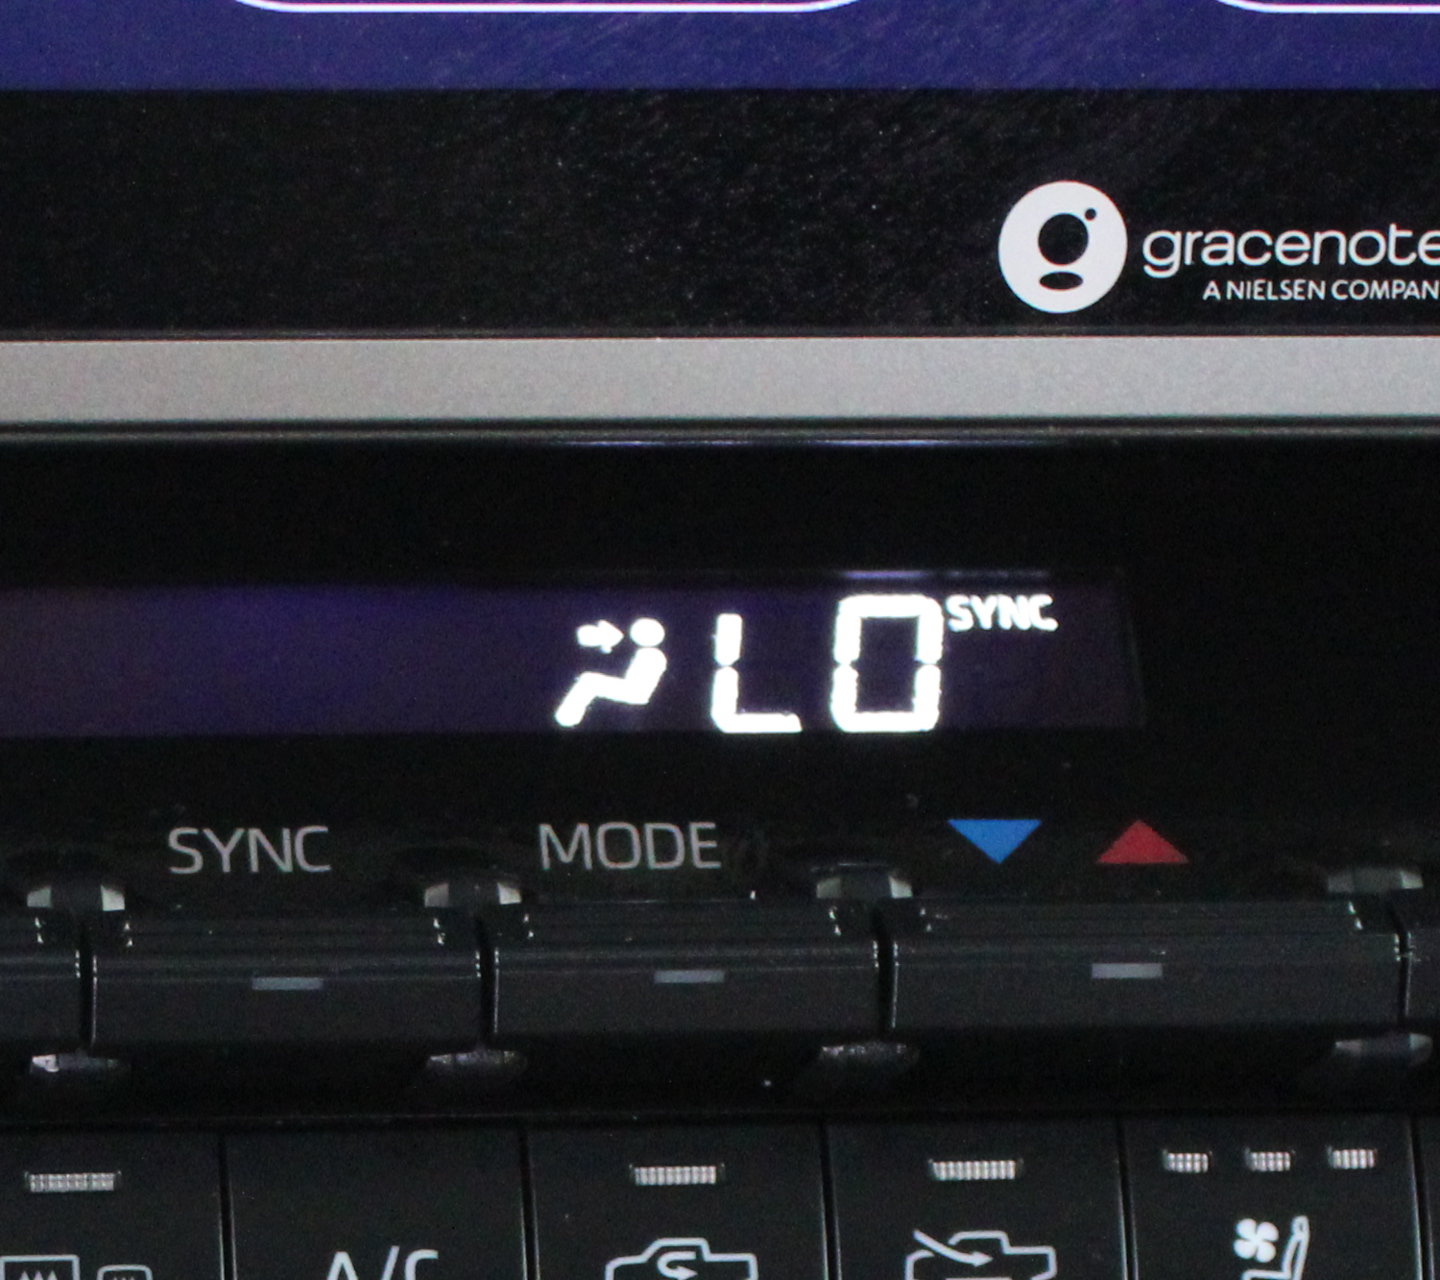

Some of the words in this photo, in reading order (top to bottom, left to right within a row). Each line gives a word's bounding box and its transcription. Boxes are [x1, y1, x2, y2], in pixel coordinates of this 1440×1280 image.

[1203, 281, 1221, 300] A
[1227, 279, 1325, 300] NIELSEN
[946, 594, 1058, 632] SYNC
[710, 593, 945, 734] LO
[169, 826, 331, 874] SYNC
[539, 822, 721, 870] MODE
